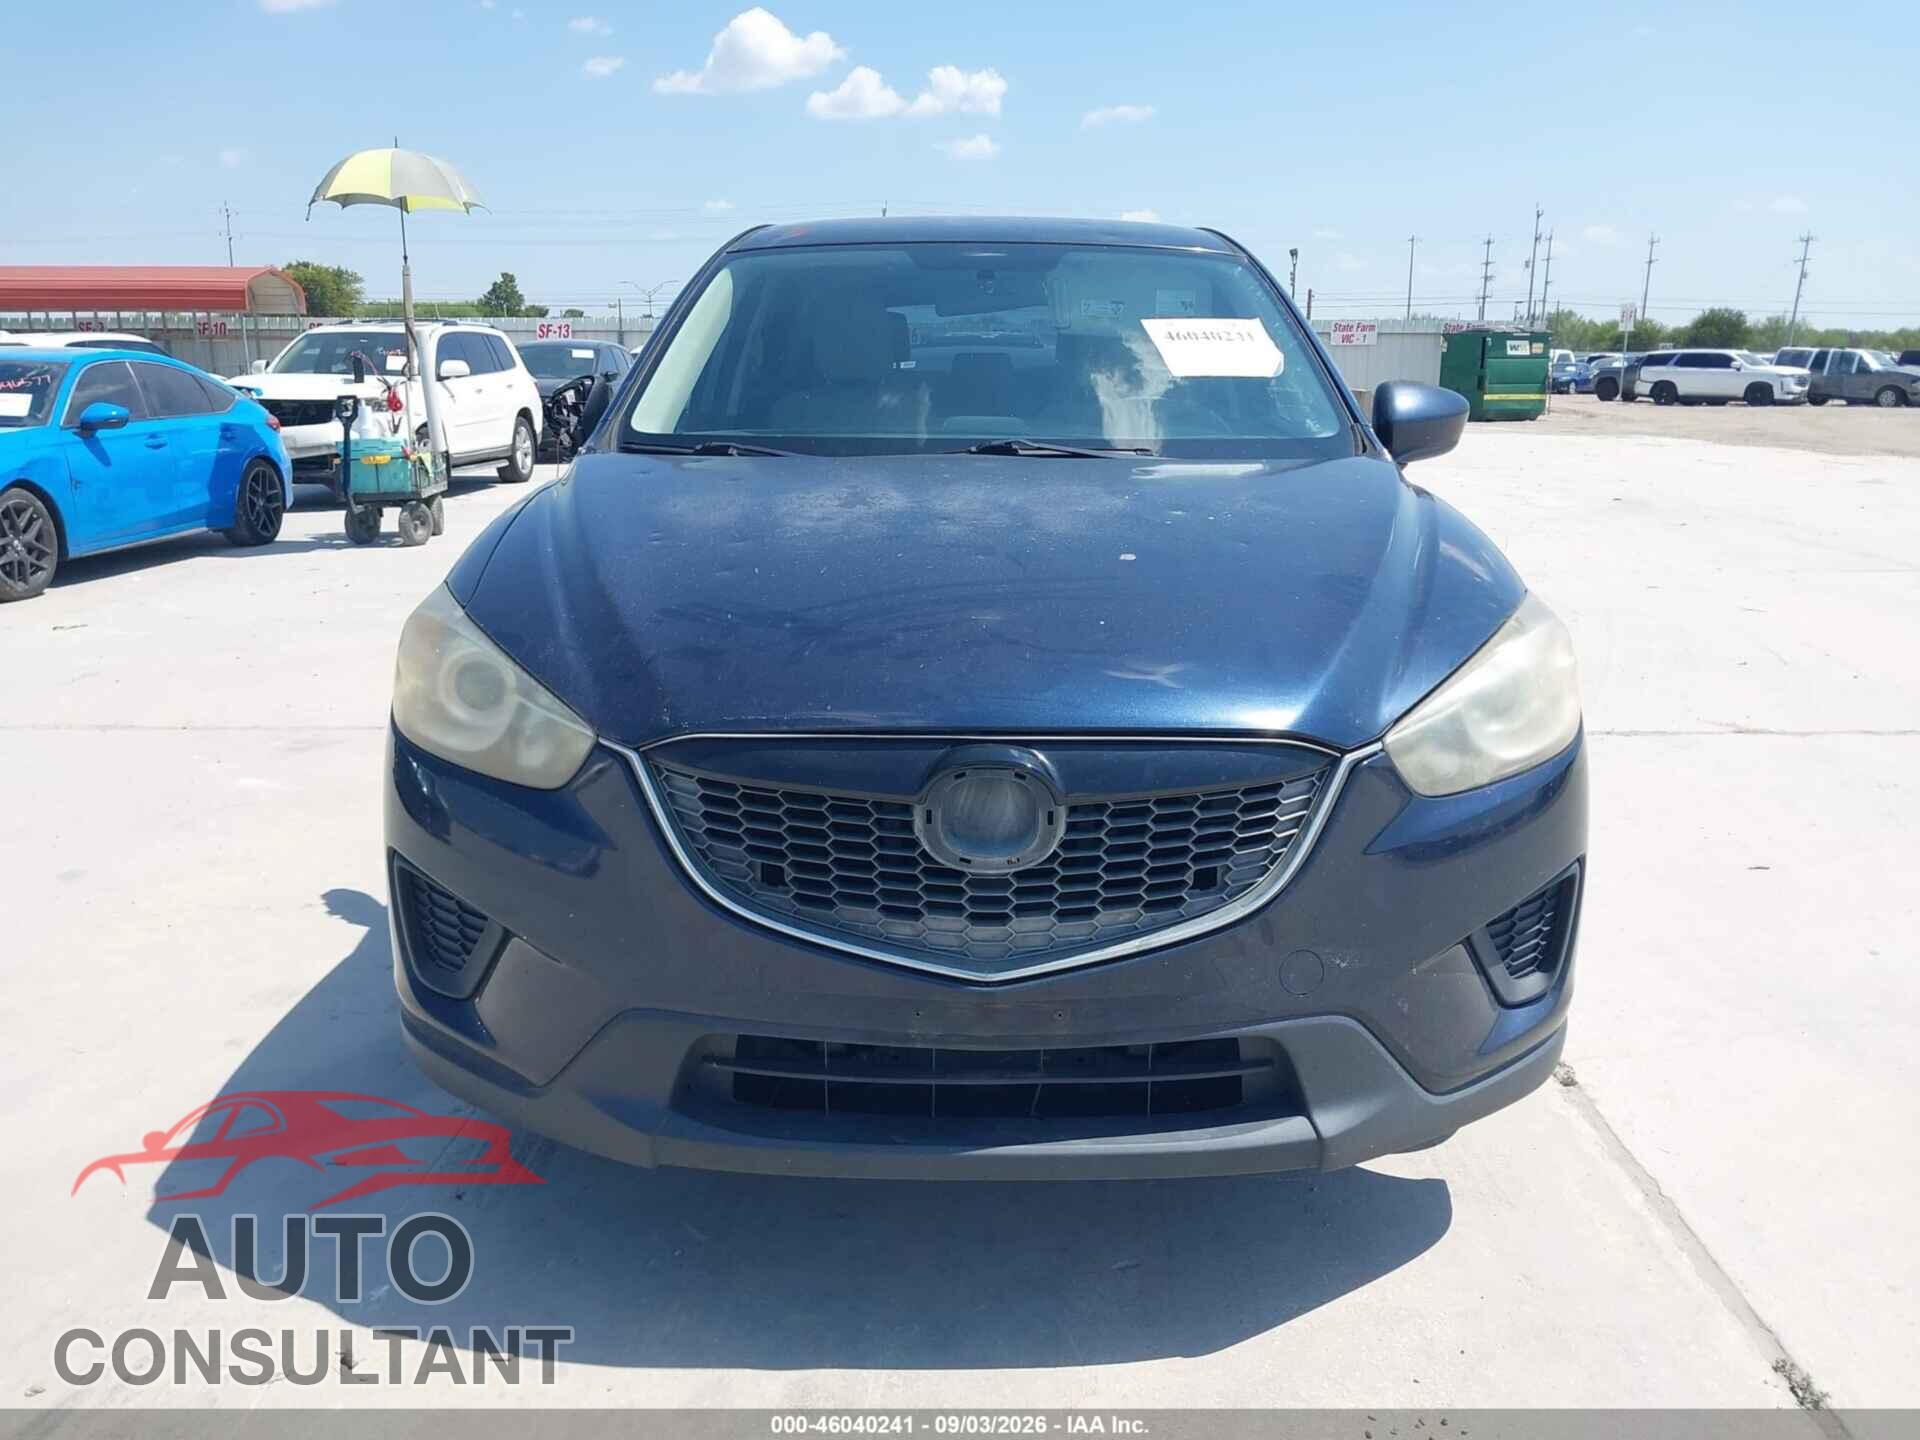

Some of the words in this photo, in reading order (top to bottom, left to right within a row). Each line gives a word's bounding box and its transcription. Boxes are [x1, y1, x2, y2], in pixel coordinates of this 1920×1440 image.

[538, 323, 570, 338] SF-13
[1333, 321, 1354, 332] State
[1356, 321, 1376, 332] Farm
[1341, 333, 1354, 343] VIC
